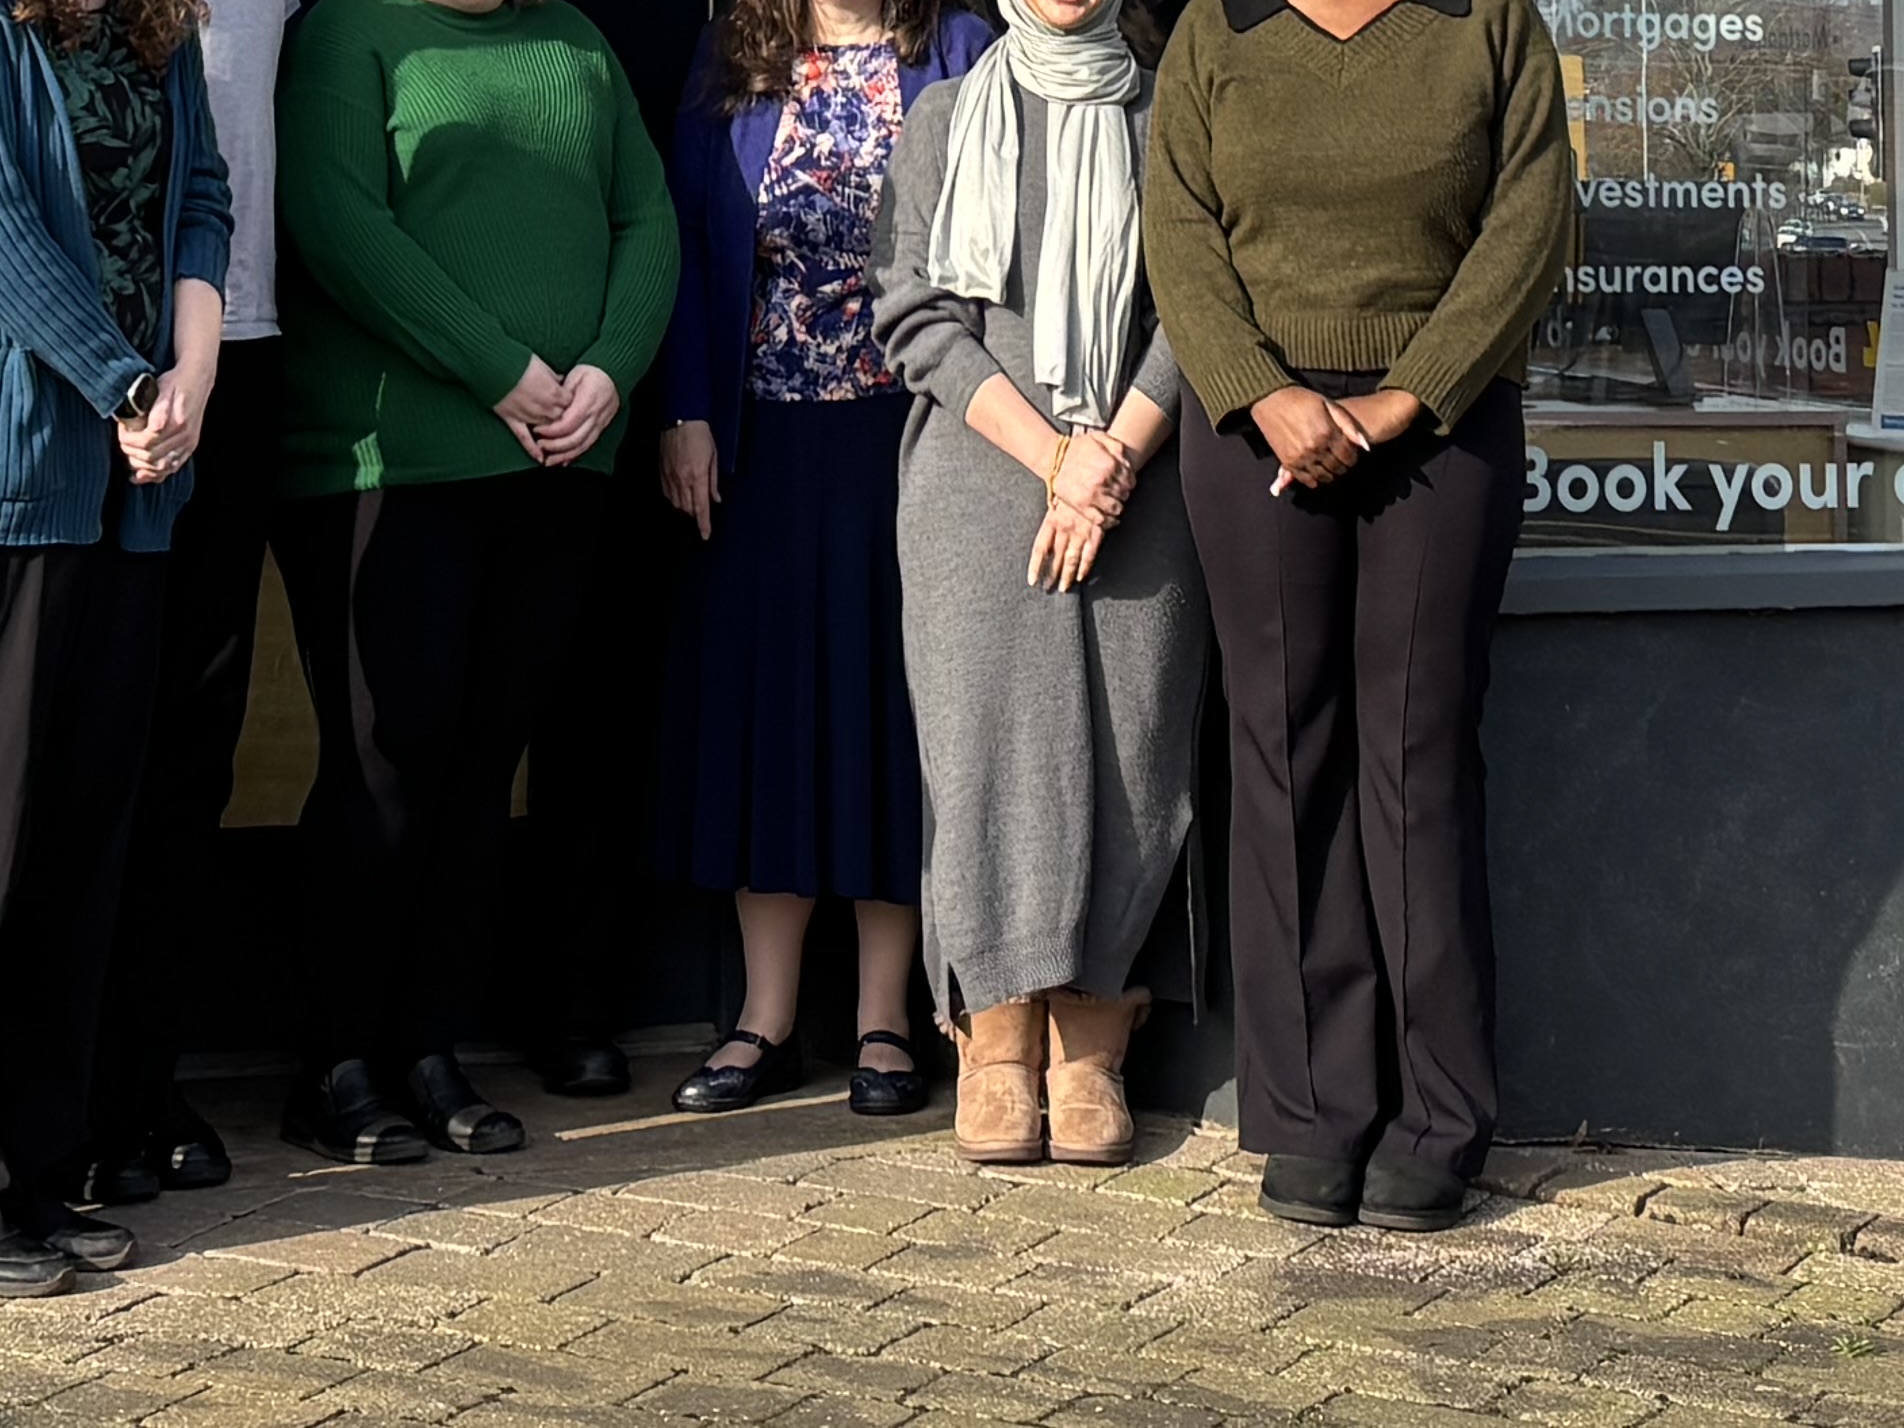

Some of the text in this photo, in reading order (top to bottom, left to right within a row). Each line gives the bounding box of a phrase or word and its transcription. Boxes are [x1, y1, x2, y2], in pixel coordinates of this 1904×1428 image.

[1566, 84, 1720, 124] ensions
[1523, 439, 1693, 514] Book
[1698, 460, 1874, 531] your
